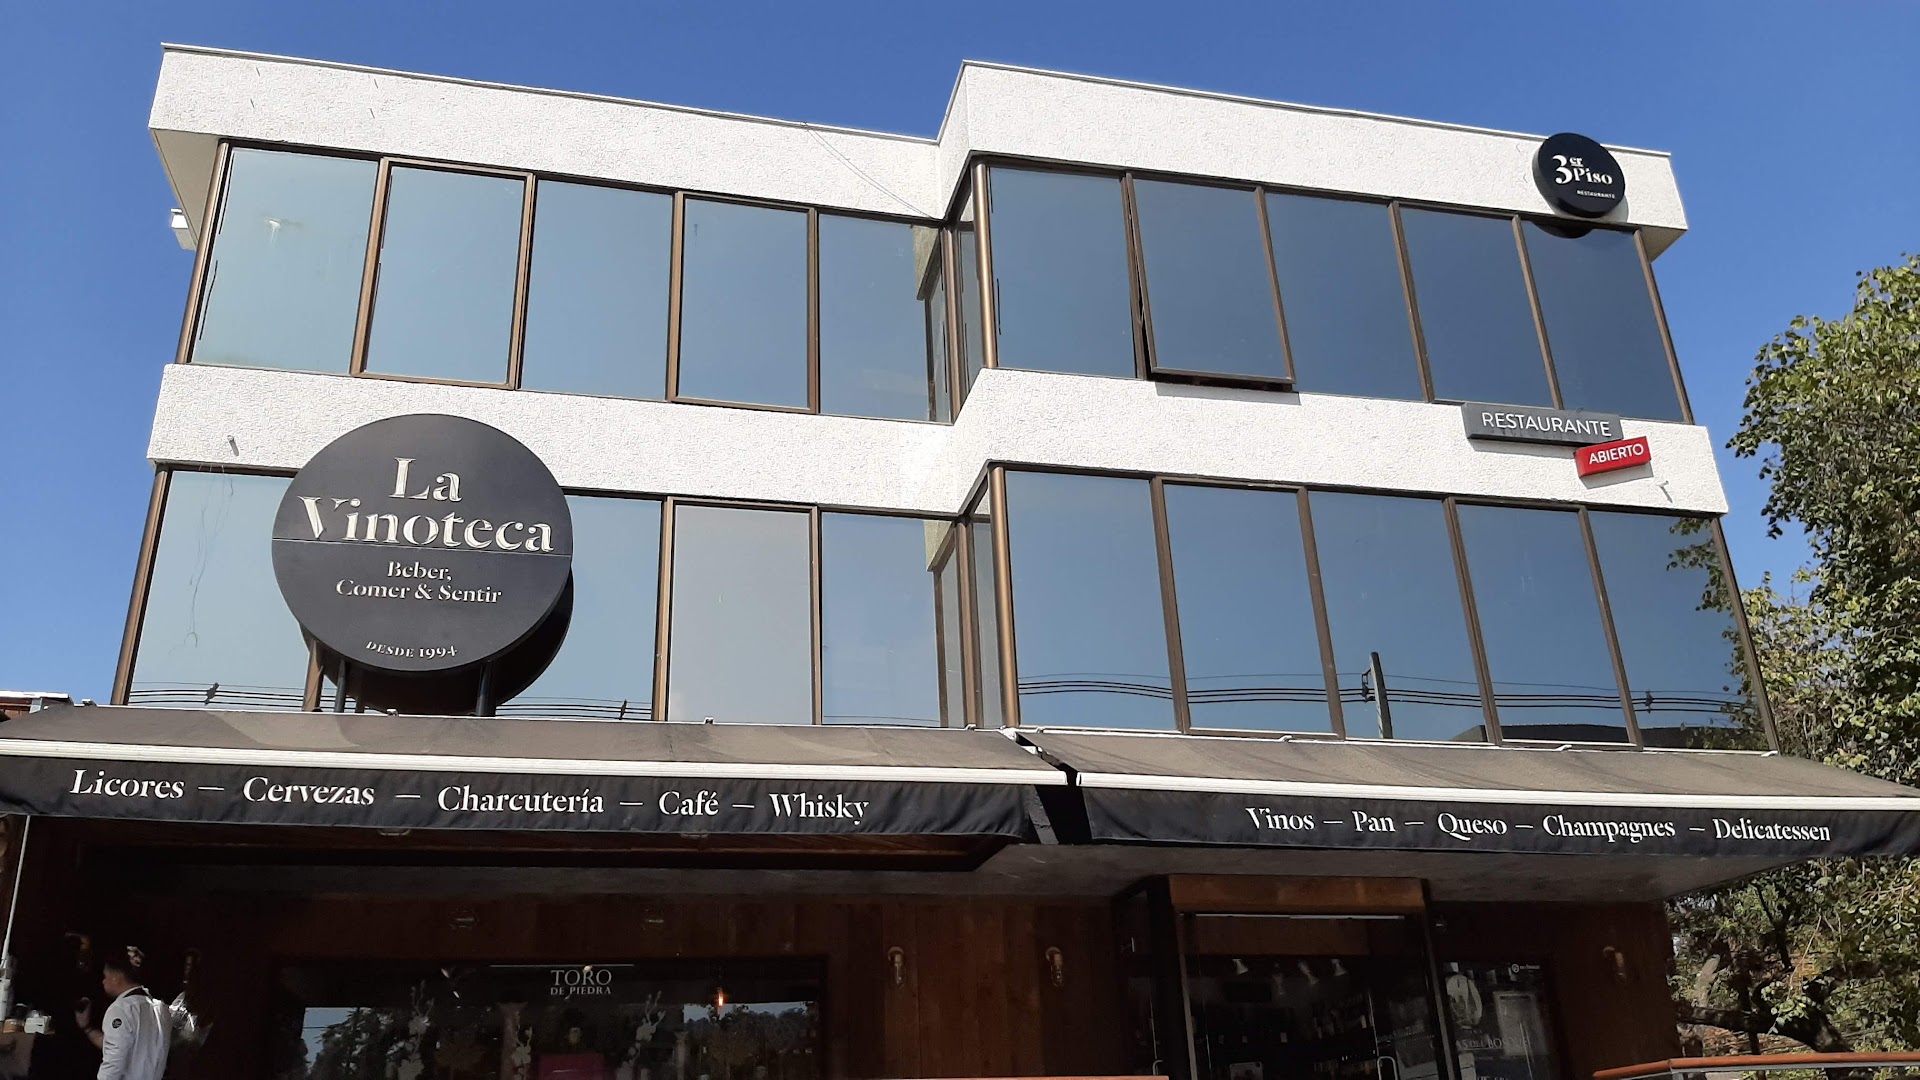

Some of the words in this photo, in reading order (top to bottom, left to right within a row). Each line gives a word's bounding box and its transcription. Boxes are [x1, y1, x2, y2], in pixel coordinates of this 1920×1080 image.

[1573, 168, 1613, 185] Piso
[1577, 190, 1615, 198] RESTAURANTE
[1482, 413, 1611, 436] RESTAURANTE
[1590, 444, 1643, 464] ABIERTO
[390, 458, 461, 501] La
[298, 495, 554, 553] Vinoteca
[387, 561, 452, 581] Beber,
[336, 578, 410, 598] Comer
[415, 584, 431, 599] &
[439, 586, 501, 602] Sentir
[366, 642, 413, 657] DESDE
[420, 646, 457, 658] 1994
[70, 770, 184, 798] Licores
[244, 777, 374, 804] Cervezas
[439, 785, 604, 812] Charcutería
[659, 791, 718, 815] Café
[769, 793, 868, 825] Whisky
[1246, 808, 1314, 829] Vinos
[1352, 811, 1395, 831] Pan
[1438, 813, 1507, 840] Queso
[1543, 815, 1675, 843] Champagnes
[1713, 818, 1830, 840] Delicatessen
[550, 969, 612, 986] TORO
[550, 987, 565, 996] DE
[569, 986, 611, 995] PIEDRA
